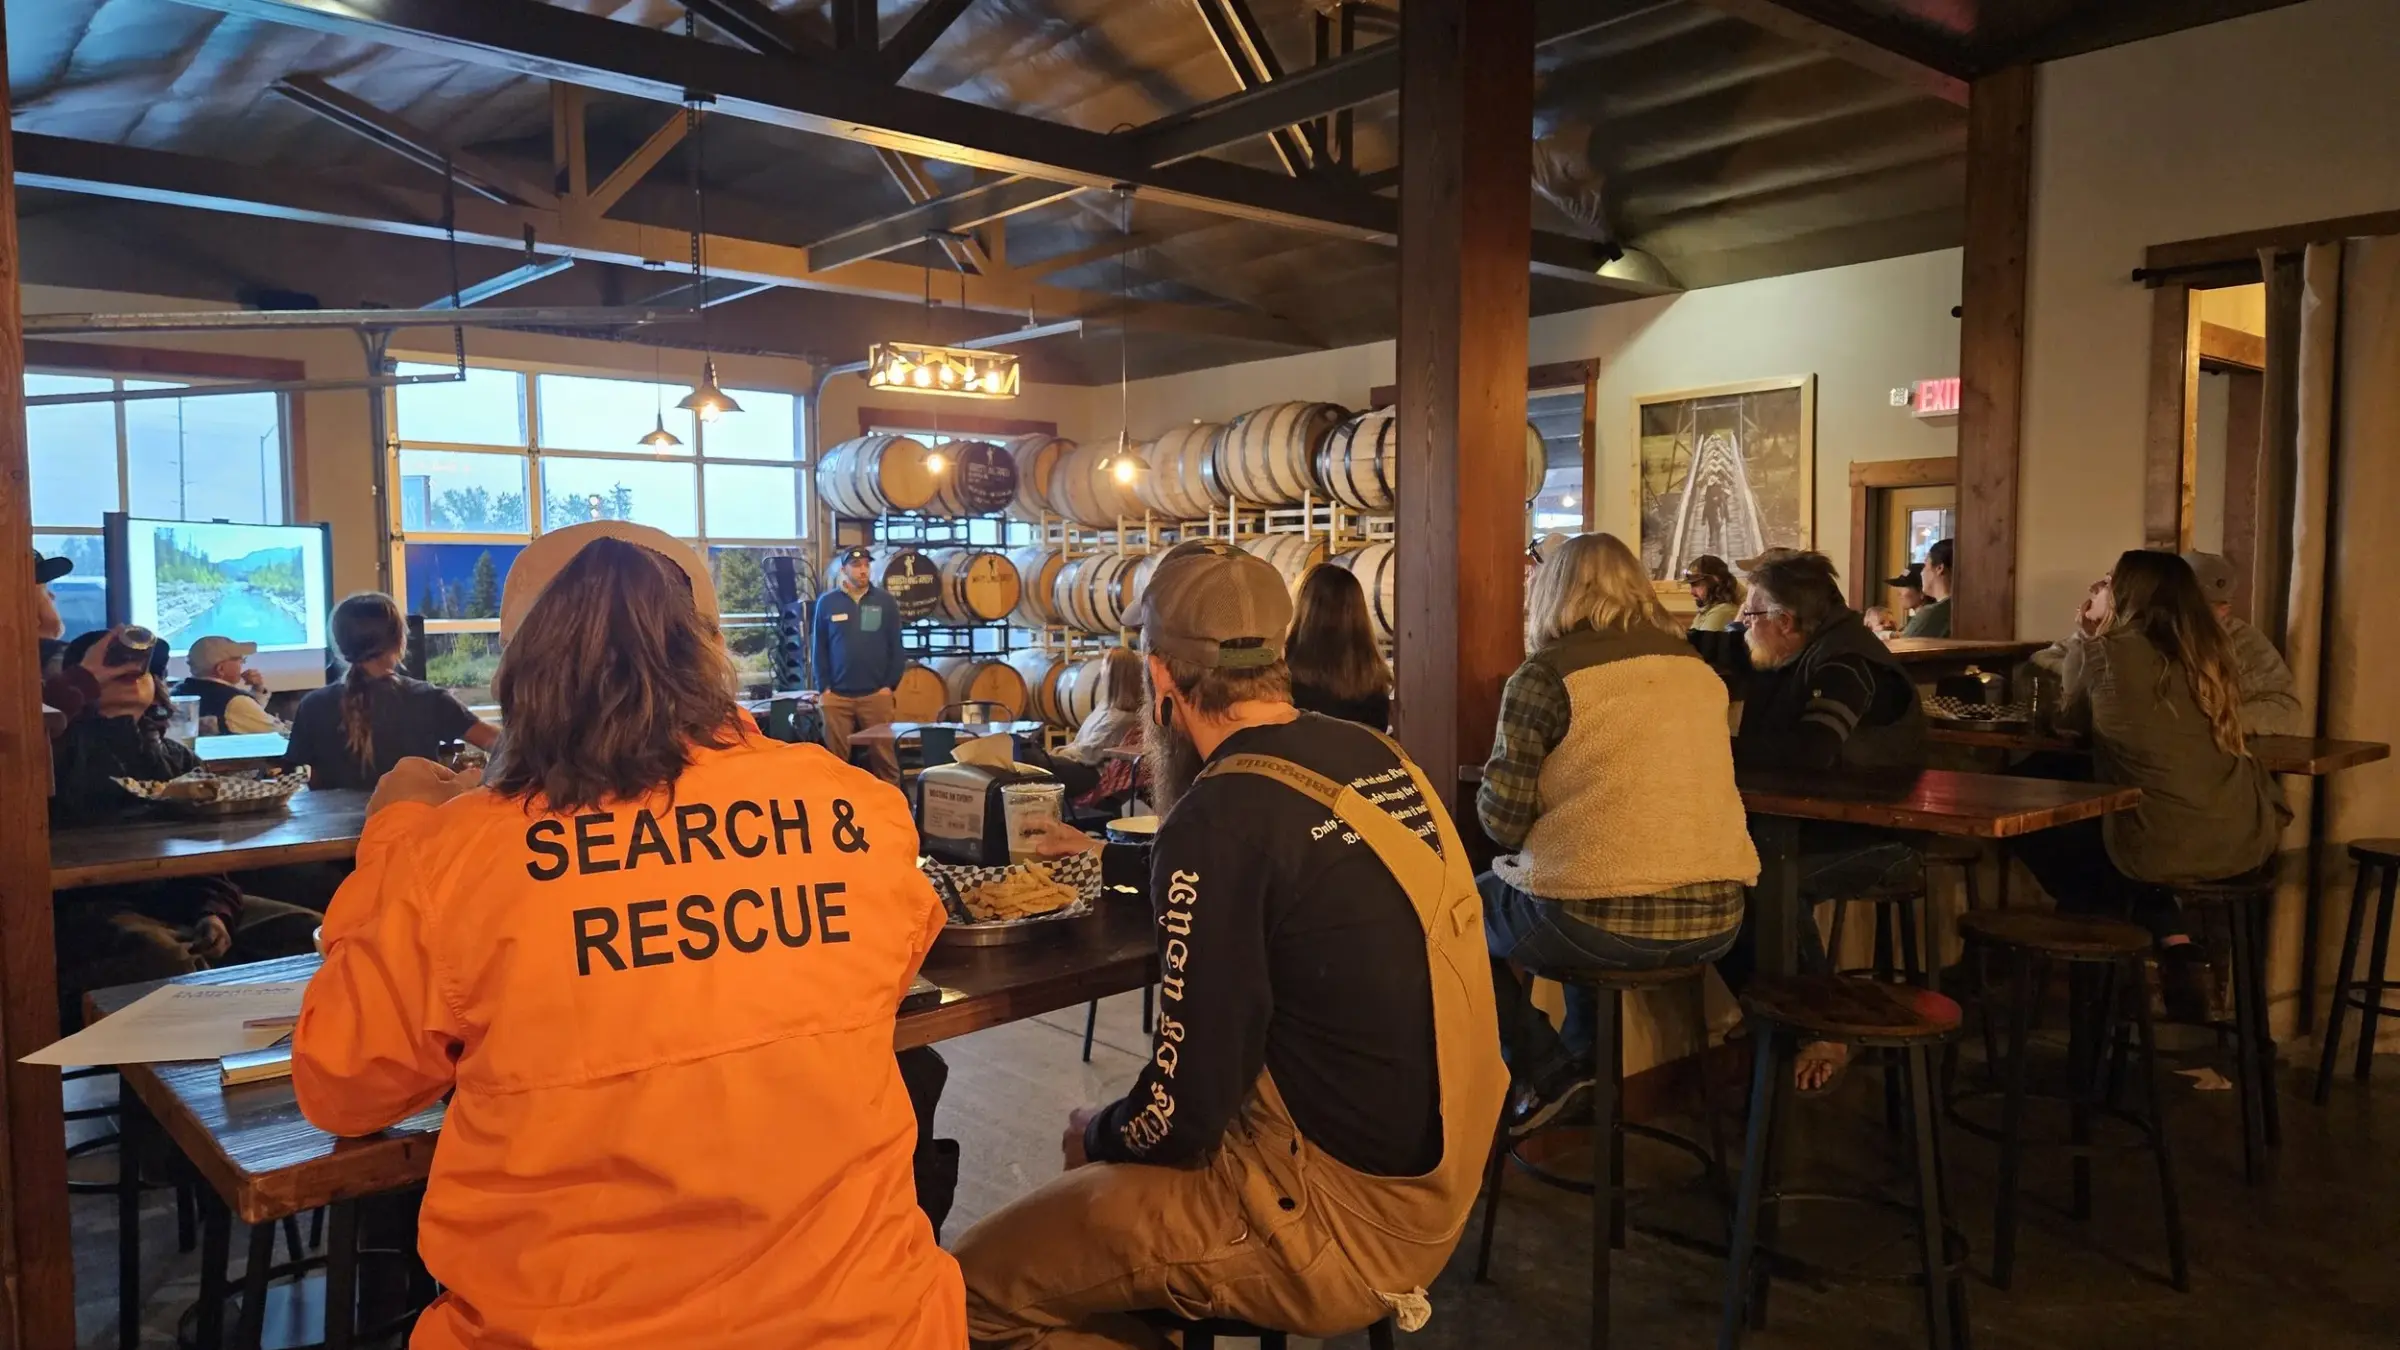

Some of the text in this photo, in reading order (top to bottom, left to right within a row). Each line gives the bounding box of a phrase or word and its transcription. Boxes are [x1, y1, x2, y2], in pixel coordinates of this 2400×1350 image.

[1921, 379, 1960, 412] EXIT
[1235, 759, 1340, 799] patagonia
[525, 798, 871, 881] SEARCH &
[1311, 819, 1338, 841] Only
[573, 882, 850, 976] RESCUE
